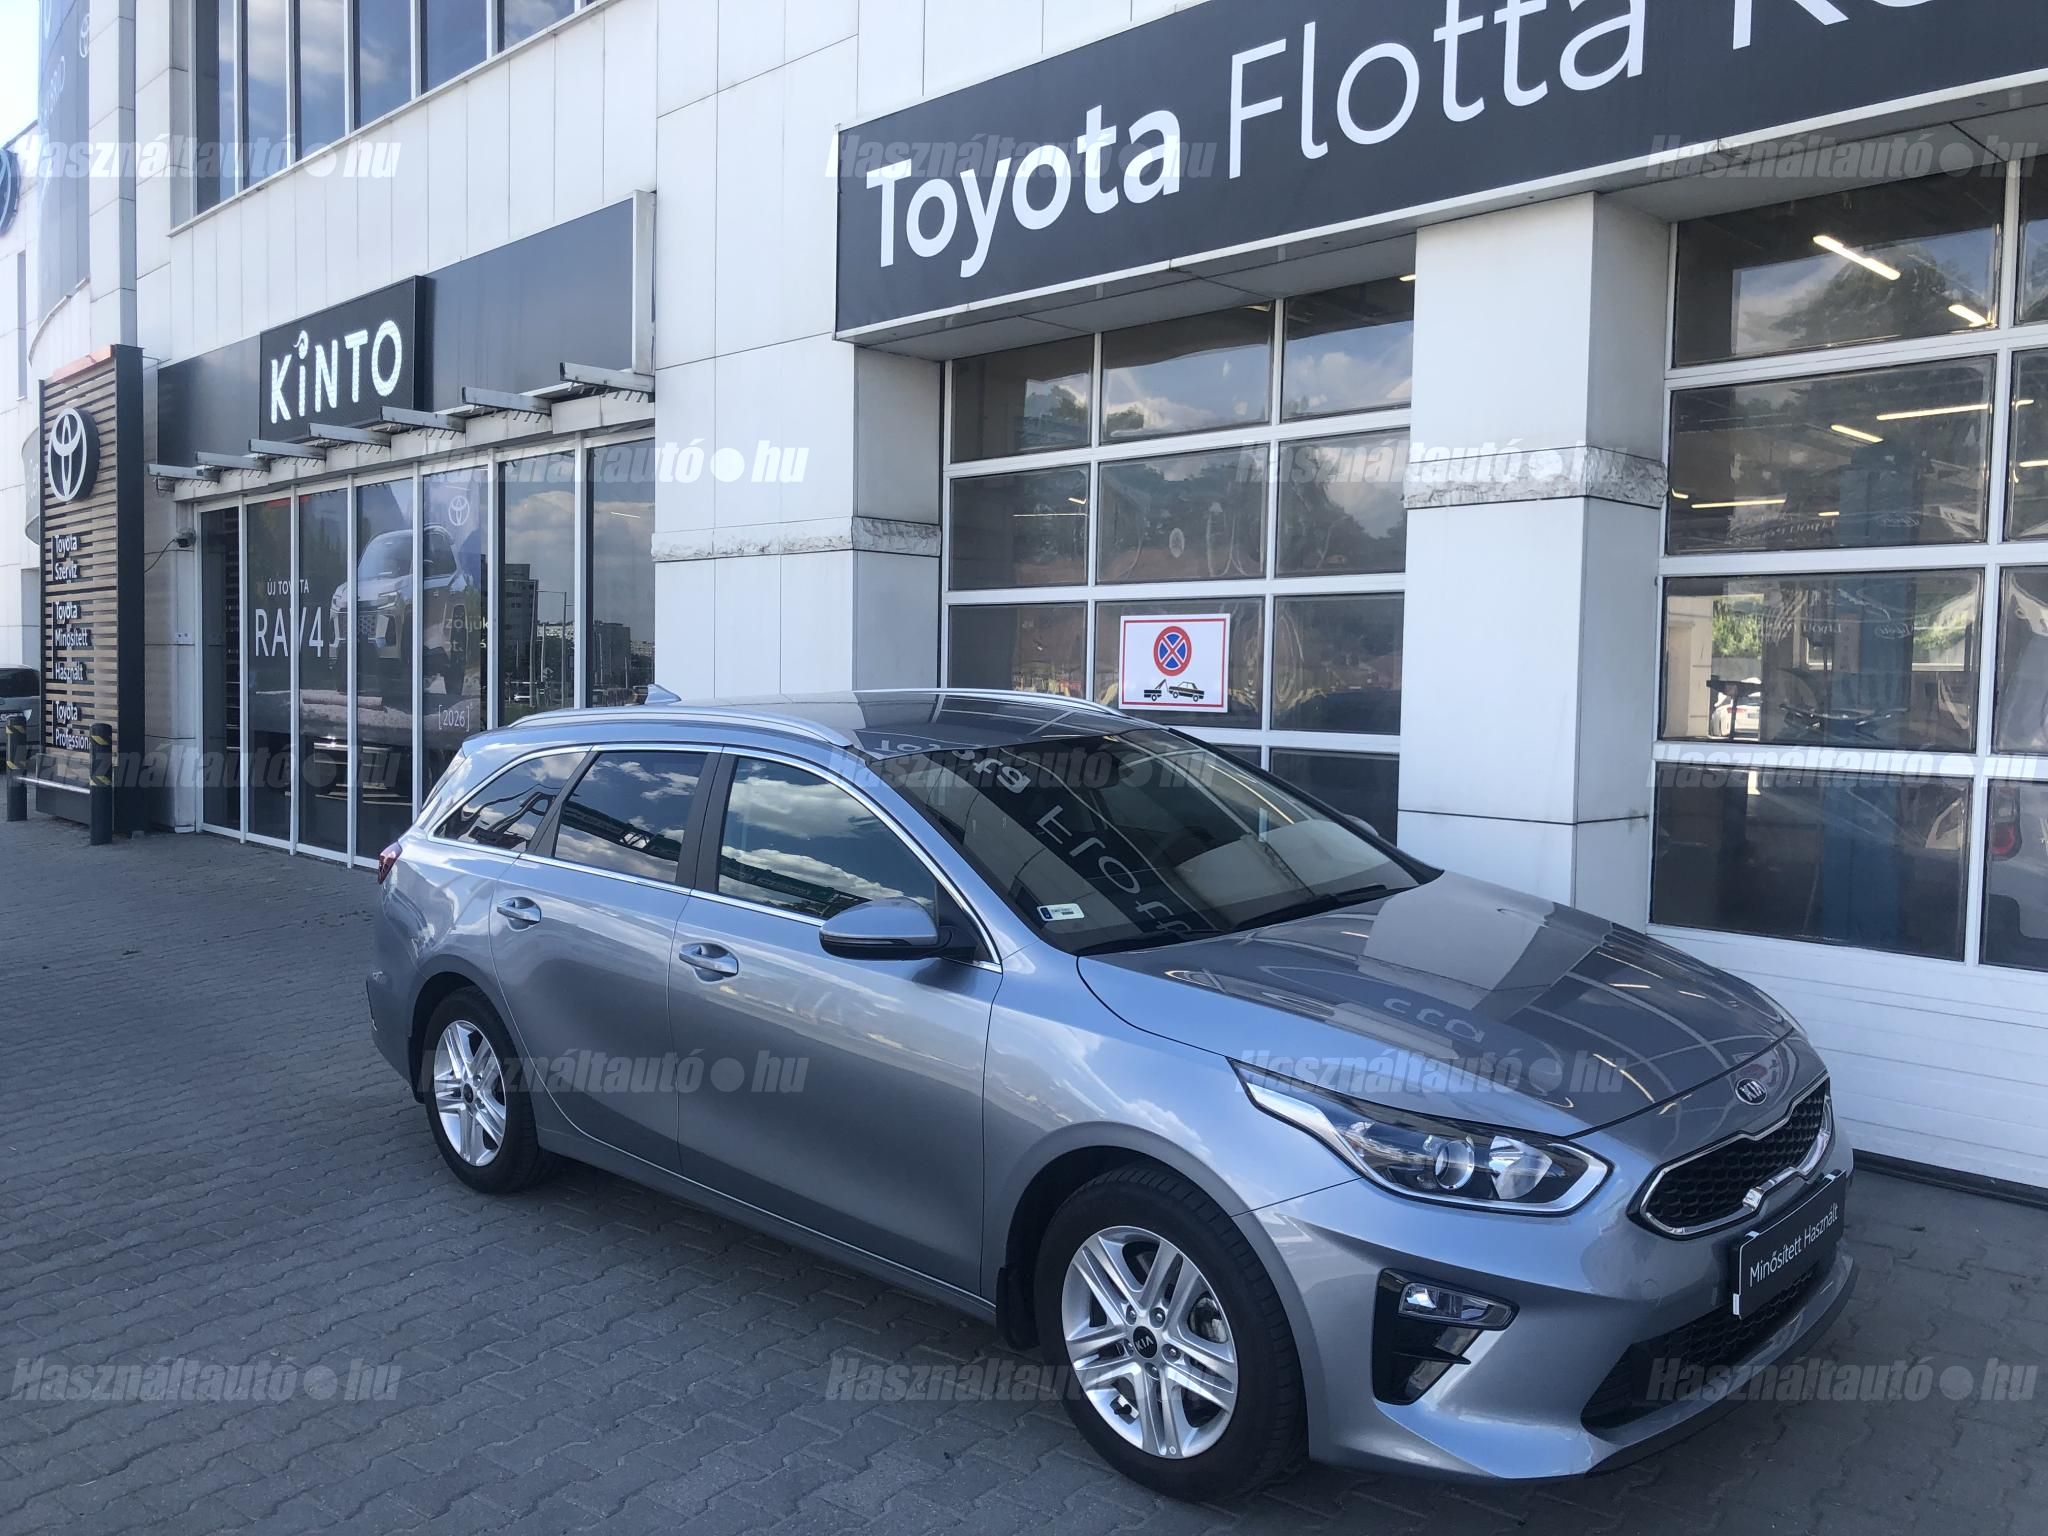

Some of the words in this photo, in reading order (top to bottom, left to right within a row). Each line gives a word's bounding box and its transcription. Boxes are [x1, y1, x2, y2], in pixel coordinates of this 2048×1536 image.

[866, 105, 1182, 278] Toyota
[1229, 0, 1646, 178] Flotta
[55, 535, 78, 557] Toyota
[55, 561, 78, 580] Szerviz
[267, 578, 276, 596] ÚJ
[278, 579, 309, 596] TOTA
[55, 601, 78, 624] Toyota
[55, 627, 88, 647] Minősített
[55, 661, 83, 680] Használt
[55, 701, 78, 724] Toyota
[55, 728, 91, 749] Profession
[1740, 1080, 1766, 1101] KIA
[1750, 1236, 1802, 1288] Minősített
[1804, 1202, 1838, 1248] Használt
[1135, 1335, 1154, 1350] KIA
